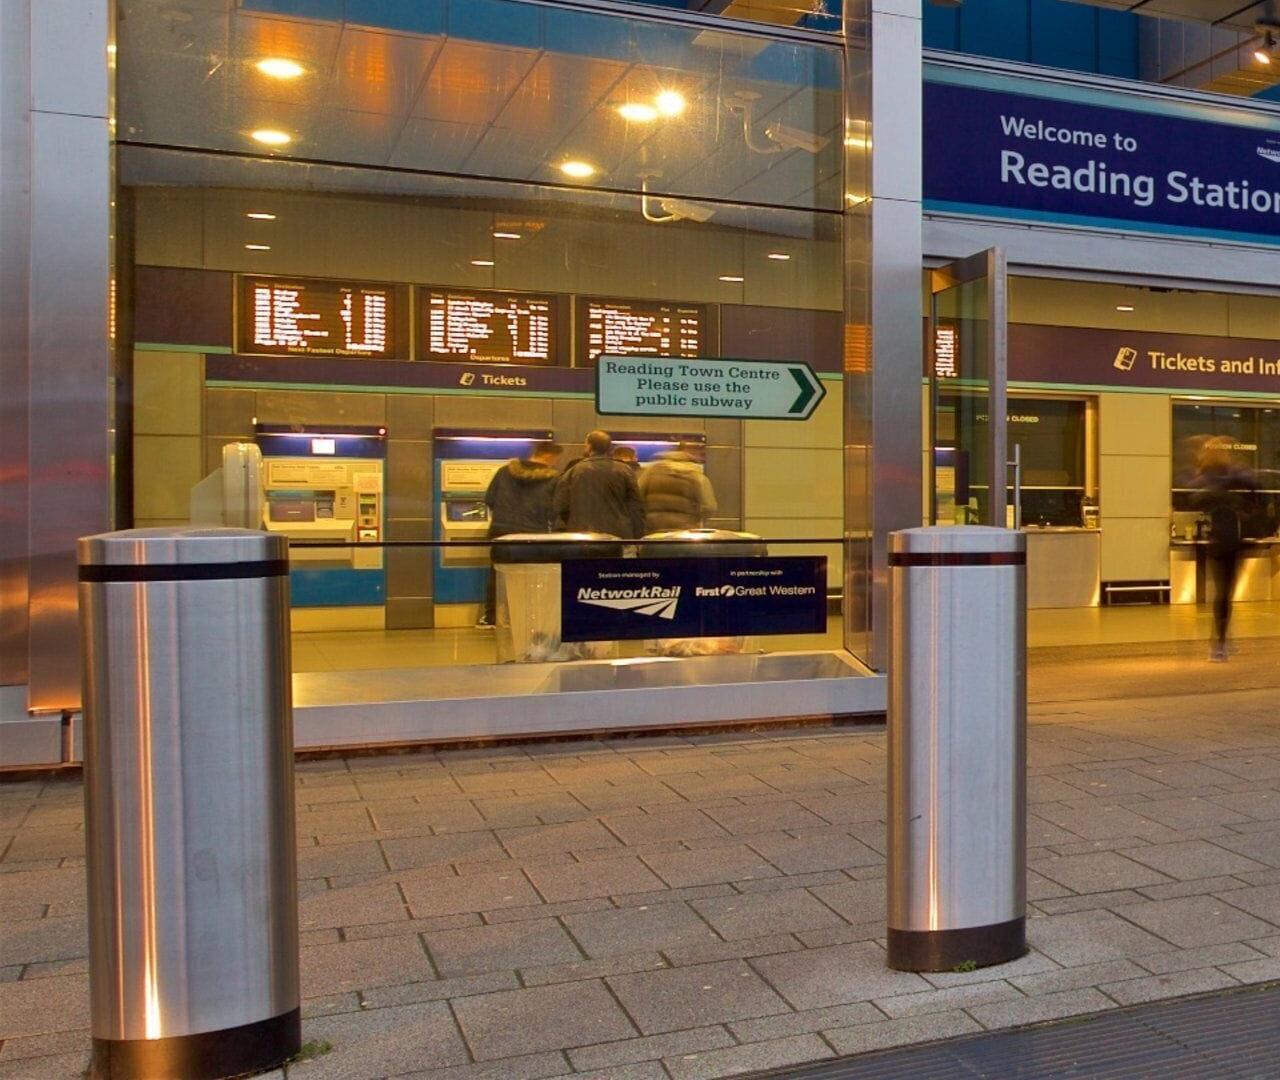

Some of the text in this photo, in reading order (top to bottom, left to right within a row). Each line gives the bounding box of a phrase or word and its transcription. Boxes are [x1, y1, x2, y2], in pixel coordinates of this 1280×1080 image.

[1000, 114, 1138, 152] Welcome to
[1000, 149, 1155, 207] Reading
[606, 361, 781, 380] Reading Town Centre
[1147, 351, 1216, 372] Tickets
[1220, 357, 1254, 374] and
[481, 374, 527, 386] Tickets
[637, 378, 751, 393] Please use the
[635, 394, 753, 410] public subway
[577, 585, 682, 600] NetworkRail
[695, 585, 816, 597] First Great Western
